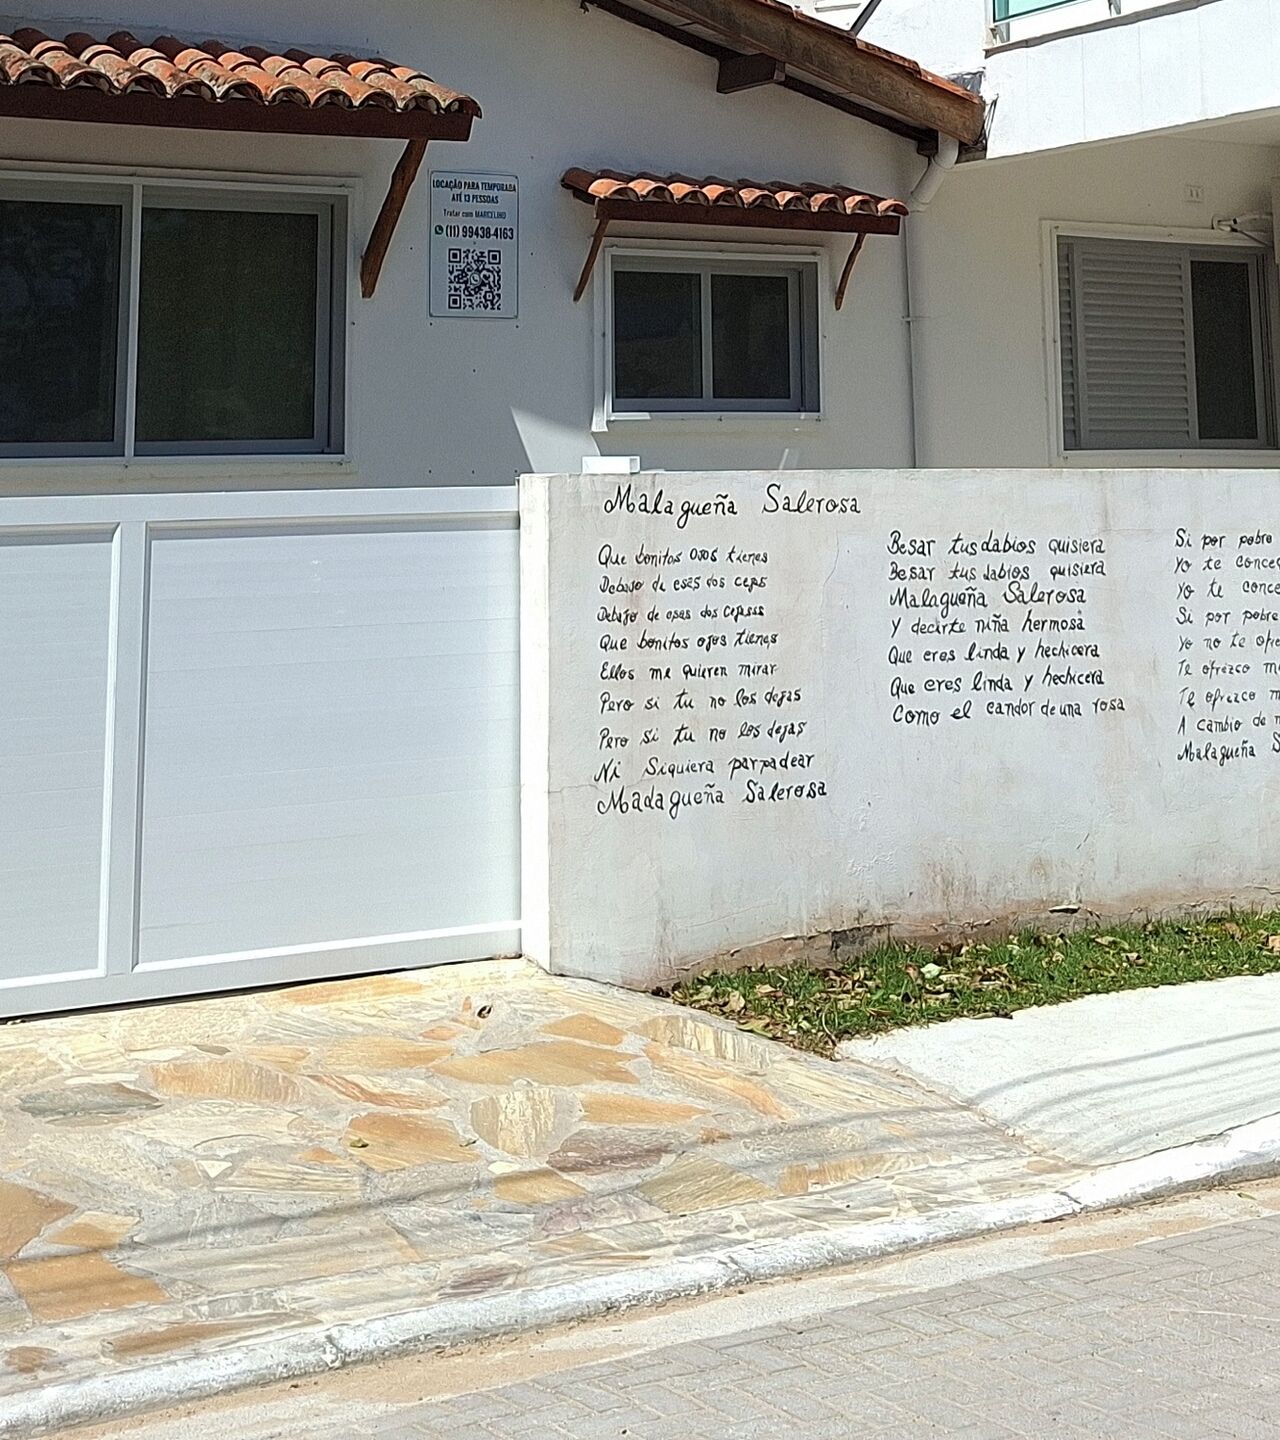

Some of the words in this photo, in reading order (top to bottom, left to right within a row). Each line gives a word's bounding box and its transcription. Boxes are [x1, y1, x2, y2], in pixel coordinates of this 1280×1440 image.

[464, 181, 479, 190] PARA
[452, 192, 462, 202] ATÉ
[464, 194, 470, 202] 13
[472, 194, 498, 204] PESSOAS
[443, 209, 460, 217] Tratar
[446, 225, 459, 237] (11)
[462, 226, 514, 240] 99438-4163
[604, 484, 737, 529] Malagueña
[762, 483, 861, 514] Salerosa
[887, 530, 936, 555] Besar
[1175, 527, 1192, 548] Si
[1201, 534, 1226, 549] por
[598, 544, 627, 567] Que
[1202, 556, 1221, 571] te
[888, 561, 936, 581] Besar
[889, 586, 988, 618] Malagueña
[1002, 581, 1086, 605] Salerosa
[1176, 606, 1193, 625] Si
[1205, 610, 1231, 627] por
[1242, 608, 1279, 626] pobre
[599, 634, 628, 652] Que
[637, 630, 690, 651] bonitos
[888, 646, 913, 666] Que
[964, 642, 1010, 661] linda
[600, 662, 635, 680] Ellos
[738, 662, 777, 676] mirar
[890, 677, 916, 699] Que
[924, 677, 962, 693] eres
[970, 671, 1013, 692] linda
[600, 691, 634, 714] Pero
[673, 689, 695, 710] tu
[710, 696, 727, 708] no
[733, 689, 757, 707] los
[892, 704, 939, 726] Como
[950, 700, 972, 720] el
[1093, 698, 1126, 714] rosa
[1177, 716, 1186, 735] A
[1196, 715, 1243, 734] cambio
[1253, 711, 1267, 727] de
[599, 728, 629, 750] Pero
[673, 724, 696, 746] tu
[709, 728, 727, 741] no
[1177, 740, 1256, 767] Malagueña
[594, 758, 621, 783] Ni
[728, 751, 815, 780] parpadear
[742, 779, 827, 804] Salerosa
